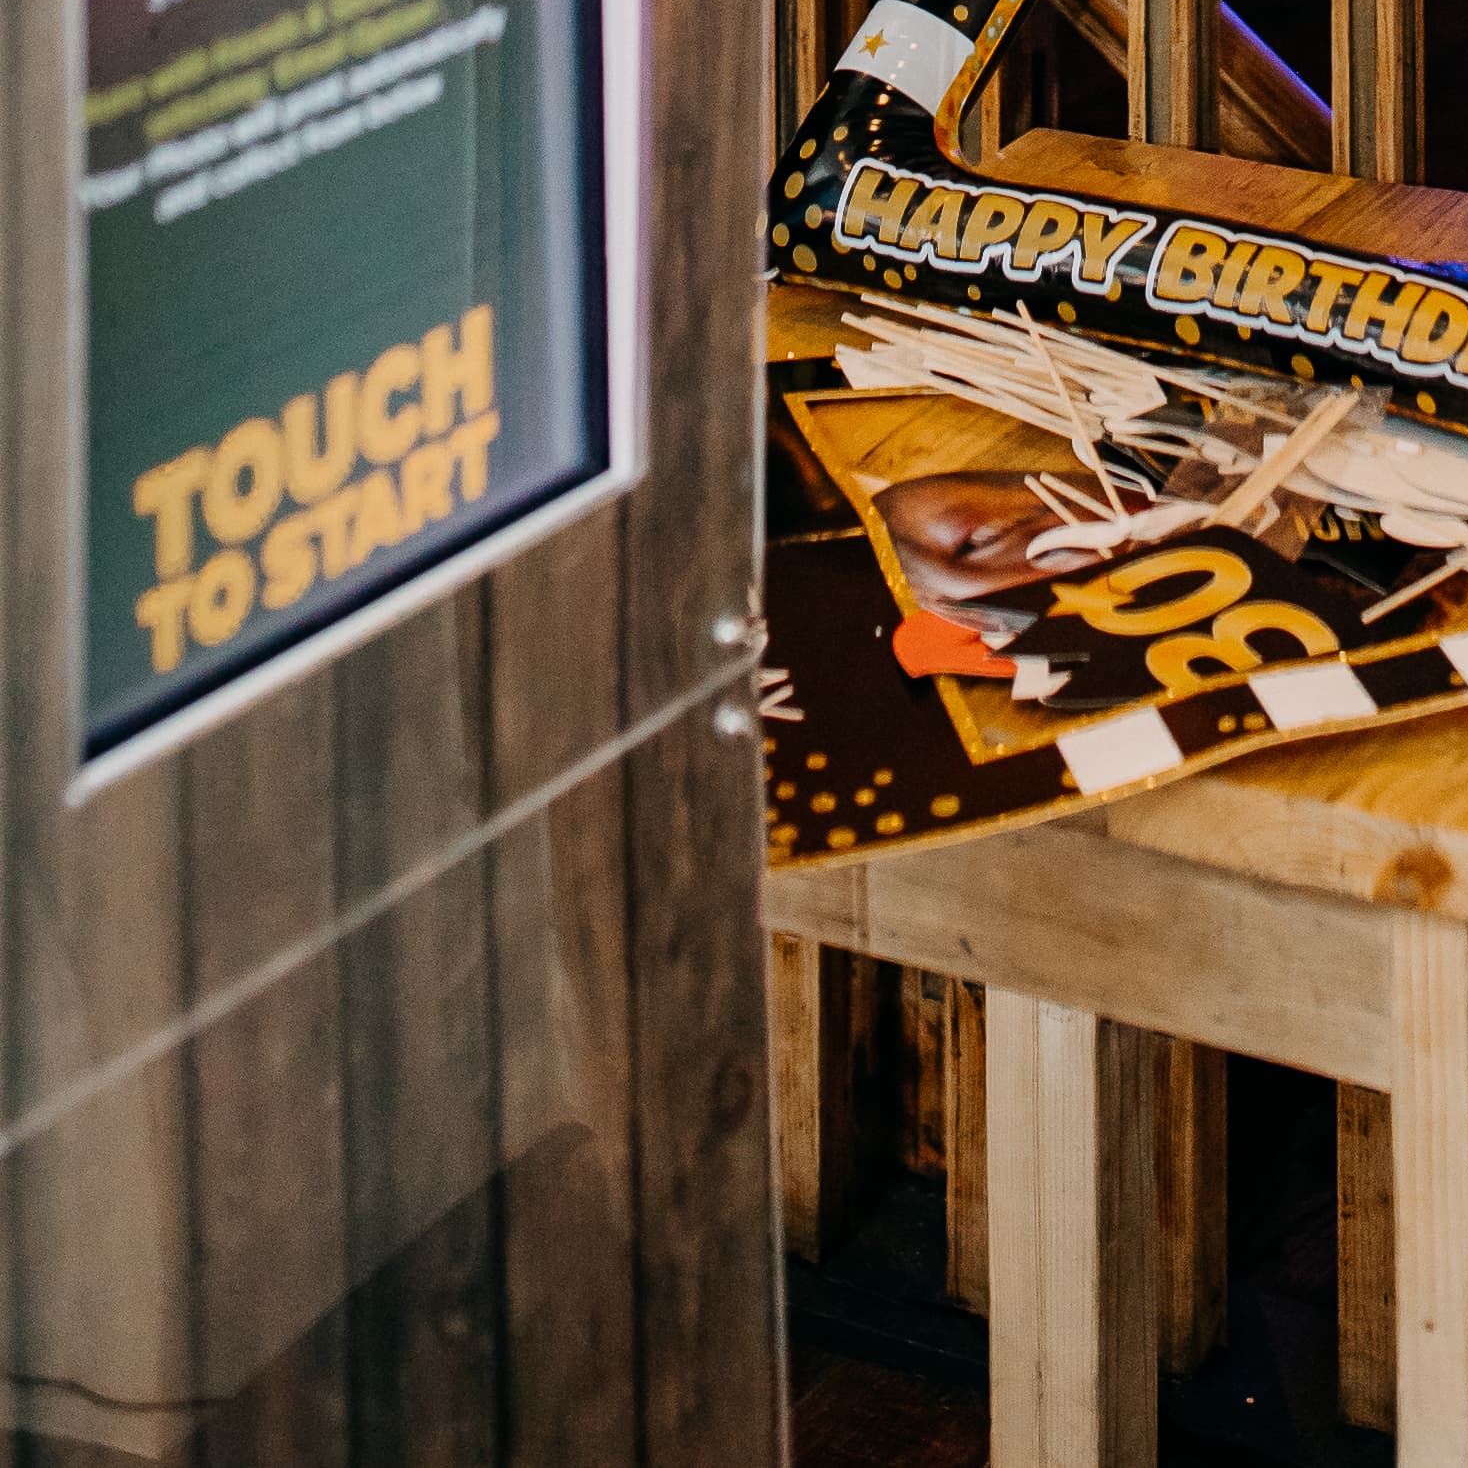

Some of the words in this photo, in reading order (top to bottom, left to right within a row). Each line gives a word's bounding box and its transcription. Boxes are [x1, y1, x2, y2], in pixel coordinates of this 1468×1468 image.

[838, 159, 1154, 291] HAPPY
[132, 301, 495, 579] TOUCH
[134, 546, 257, 675] TO
[260, 409, 501, 610] START
